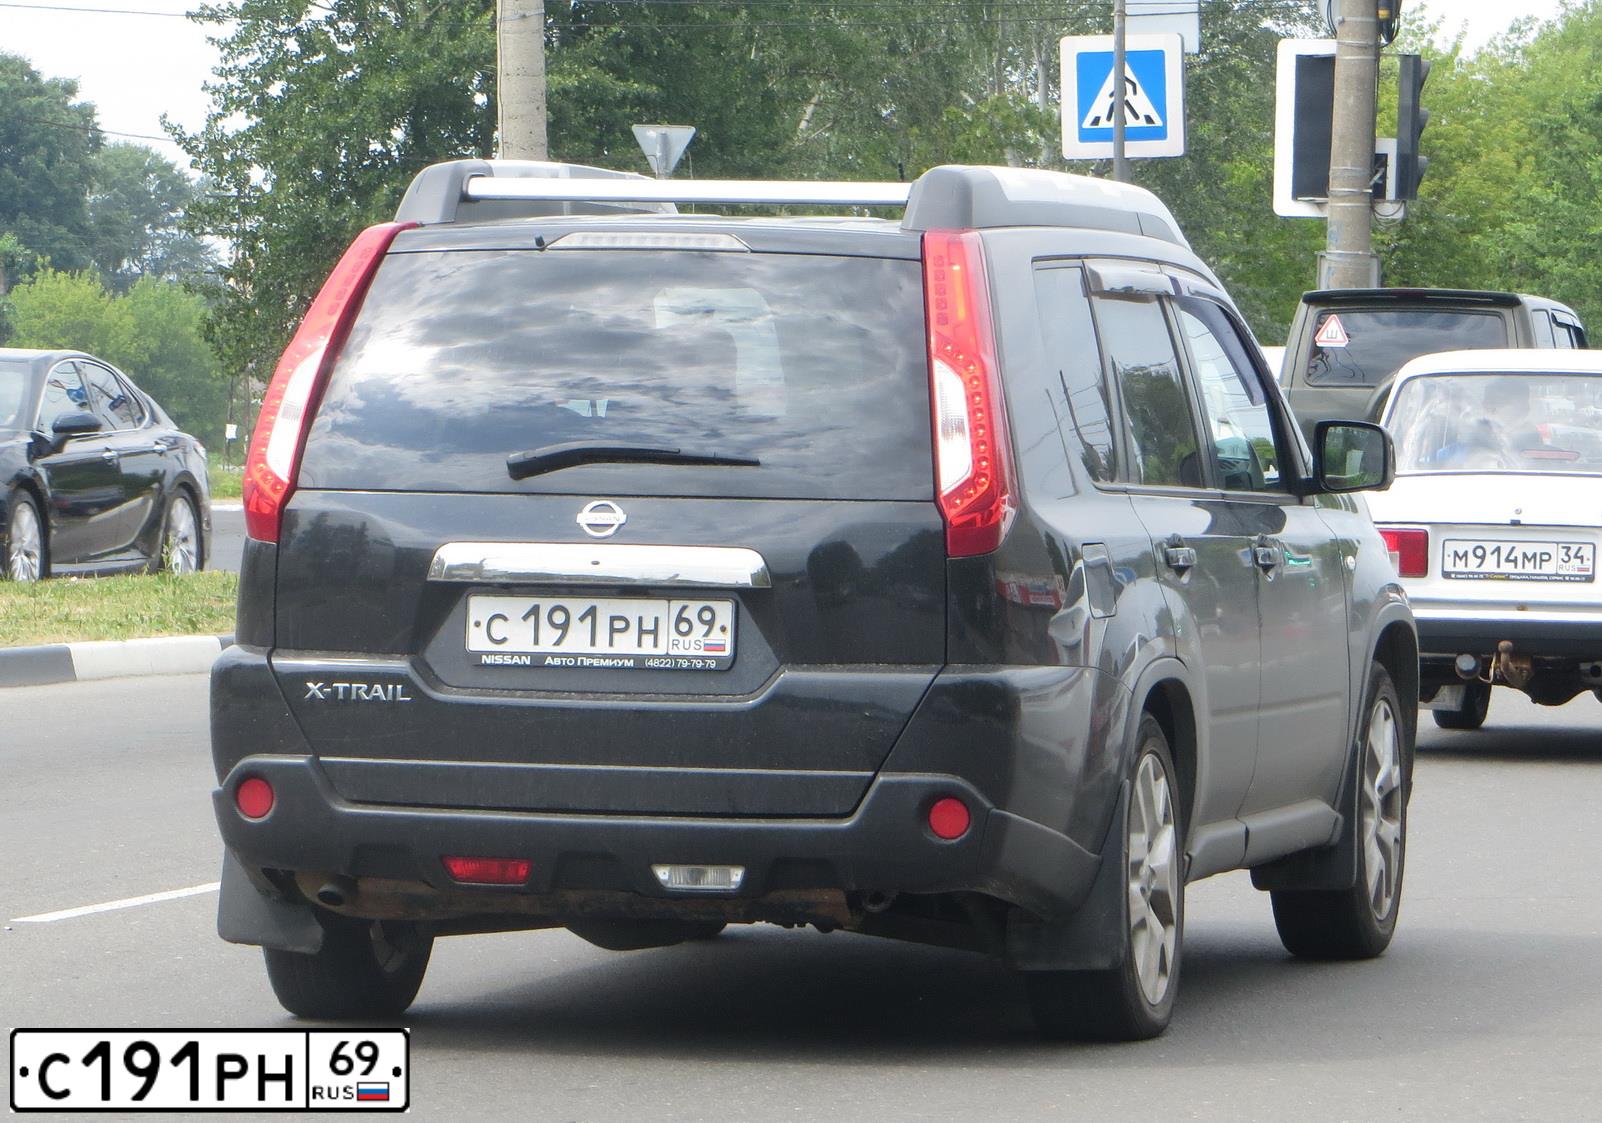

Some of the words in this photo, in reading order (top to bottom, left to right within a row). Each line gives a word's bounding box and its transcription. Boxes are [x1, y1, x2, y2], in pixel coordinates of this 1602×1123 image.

[1326, 329, 1338, 340] Ш
[1453, 545, 1552, 570] М914МР
[1560, 546, 1584, 565] 34
[486, 603, 659, 649] С191РН
[674, 604, 716, 638] 69
[671, 639, 702, 651] RUS
[481, 654, 531, 665] NISSAN
[644, 658, 675, 669] (4822)
[677, 659, 717, 669] 79-79-79
[304, 682, 413, 701] X-TRAIL
